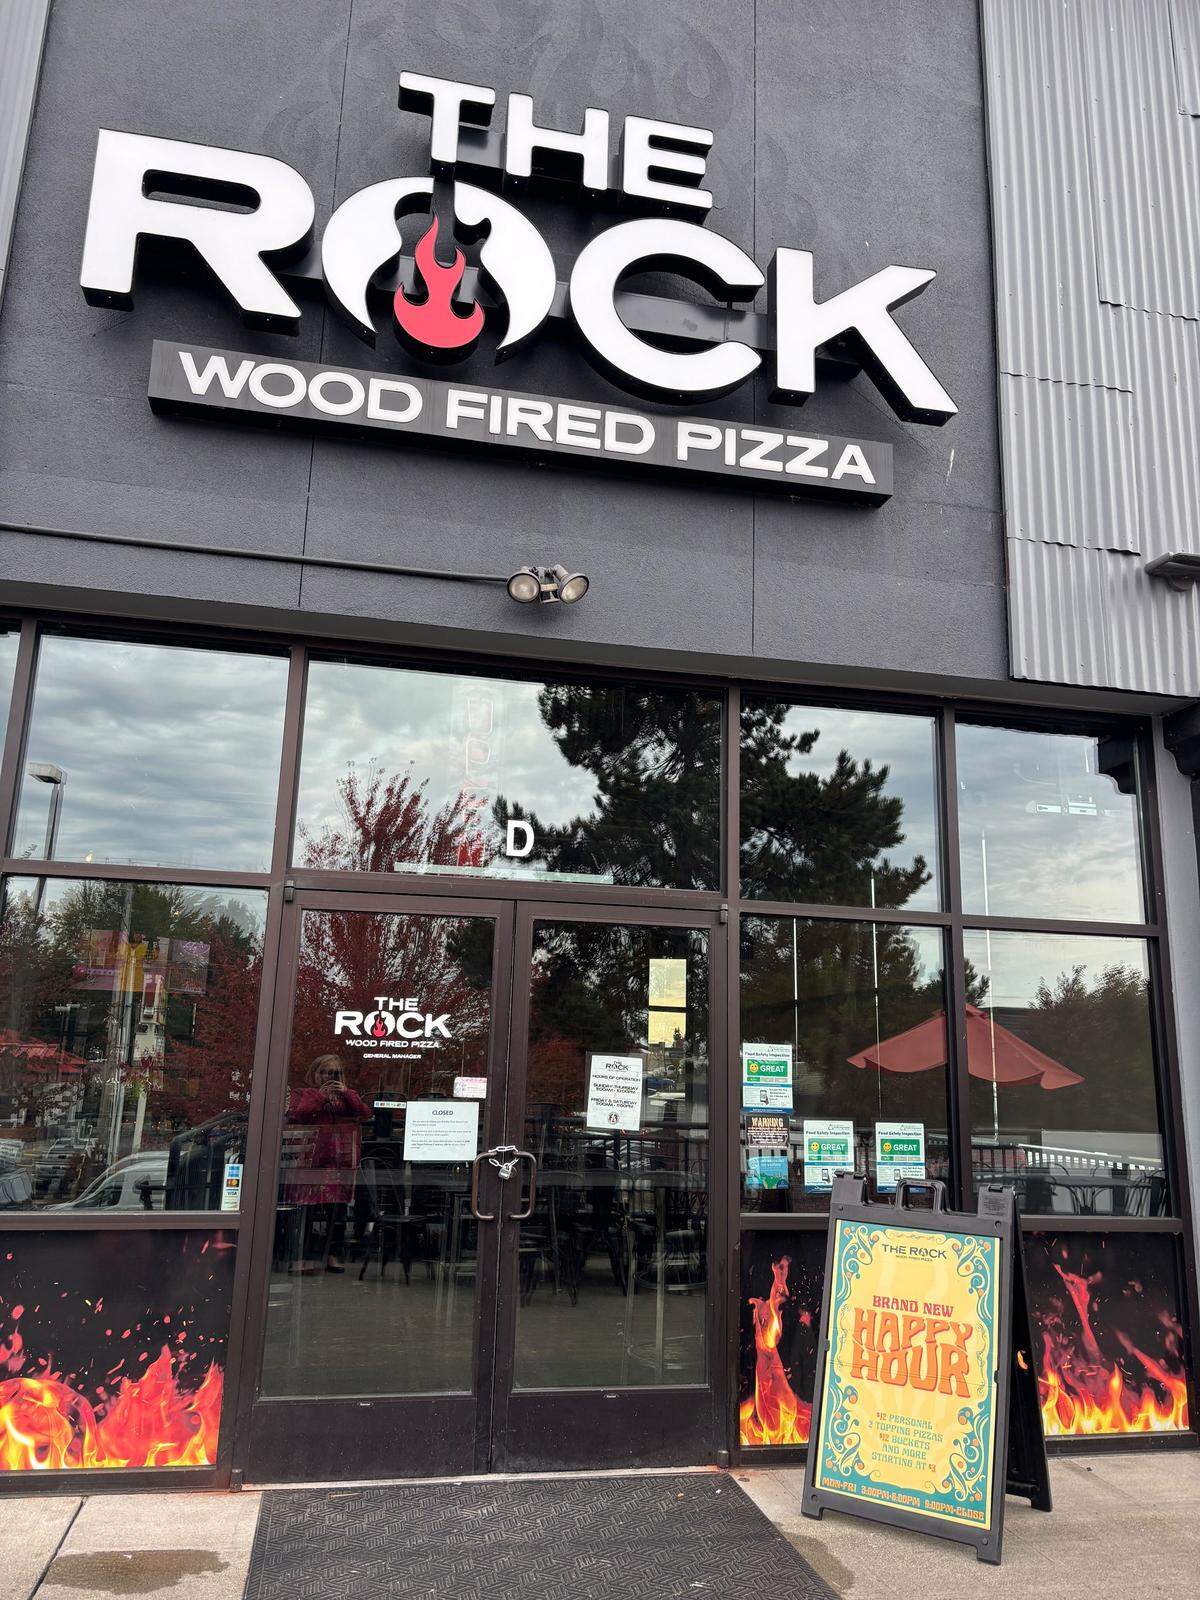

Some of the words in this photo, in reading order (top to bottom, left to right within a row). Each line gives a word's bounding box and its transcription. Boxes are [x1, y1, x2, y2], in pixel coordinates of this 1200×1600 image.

[399, 71, 714, 211] THE
[80, 127, 958, 416] ROCK
[178, 350, 423, 424] WOOD
[445, 391, 656, 456] FIRED
[677, 420, 878, 485] PIZZA
[505, 820, 535, 857] D
[374, 996, 419, 1011] THE
[334, 1010, 453, 1039] ROCK
[345, 1039, 378, 1047] WOOD
[380, 1040, 409, 1048] FIRED
[411, 1041, 440, 1049] PIZZA
[605, 1063, 629, 1071] ROCK
[752, 1117, 784, 1127] WARNING
[821, 1143, 846, 1152] GREAT
[893, 1144, 917, 1152] GREAT
[882, 1244, 907, 1255] THE
[909, 1246, 947, 1260] ROCK
[873, 1295, 919, 1313] BRAND
[923, 1302, 954, 1318] NEW
[852, 1307, 974, 1354] HAPPY
[850, 1338, 971, 1399] HOUR
[877, 1411, 887, 1421] $12
[888, 1413, 933, 1430] PERSONAL
[868, 1420, 873, 1428] 2
[875, 1421, 911, 1436] TOPPING
[913, 1429, 944, 1443] PIZZAS
[880, 1432, 889, 1442] $12
[892, 1435, 930, 1450] BUCKETS
[872, 1451, 913, 1468] STARTING
[915, 1460, 927, 1470] AT
[928, 1463, 936, 1472] $3
[882, 1443, 900, 1455] AND
[902, 1448, 927, 1460] MORE
